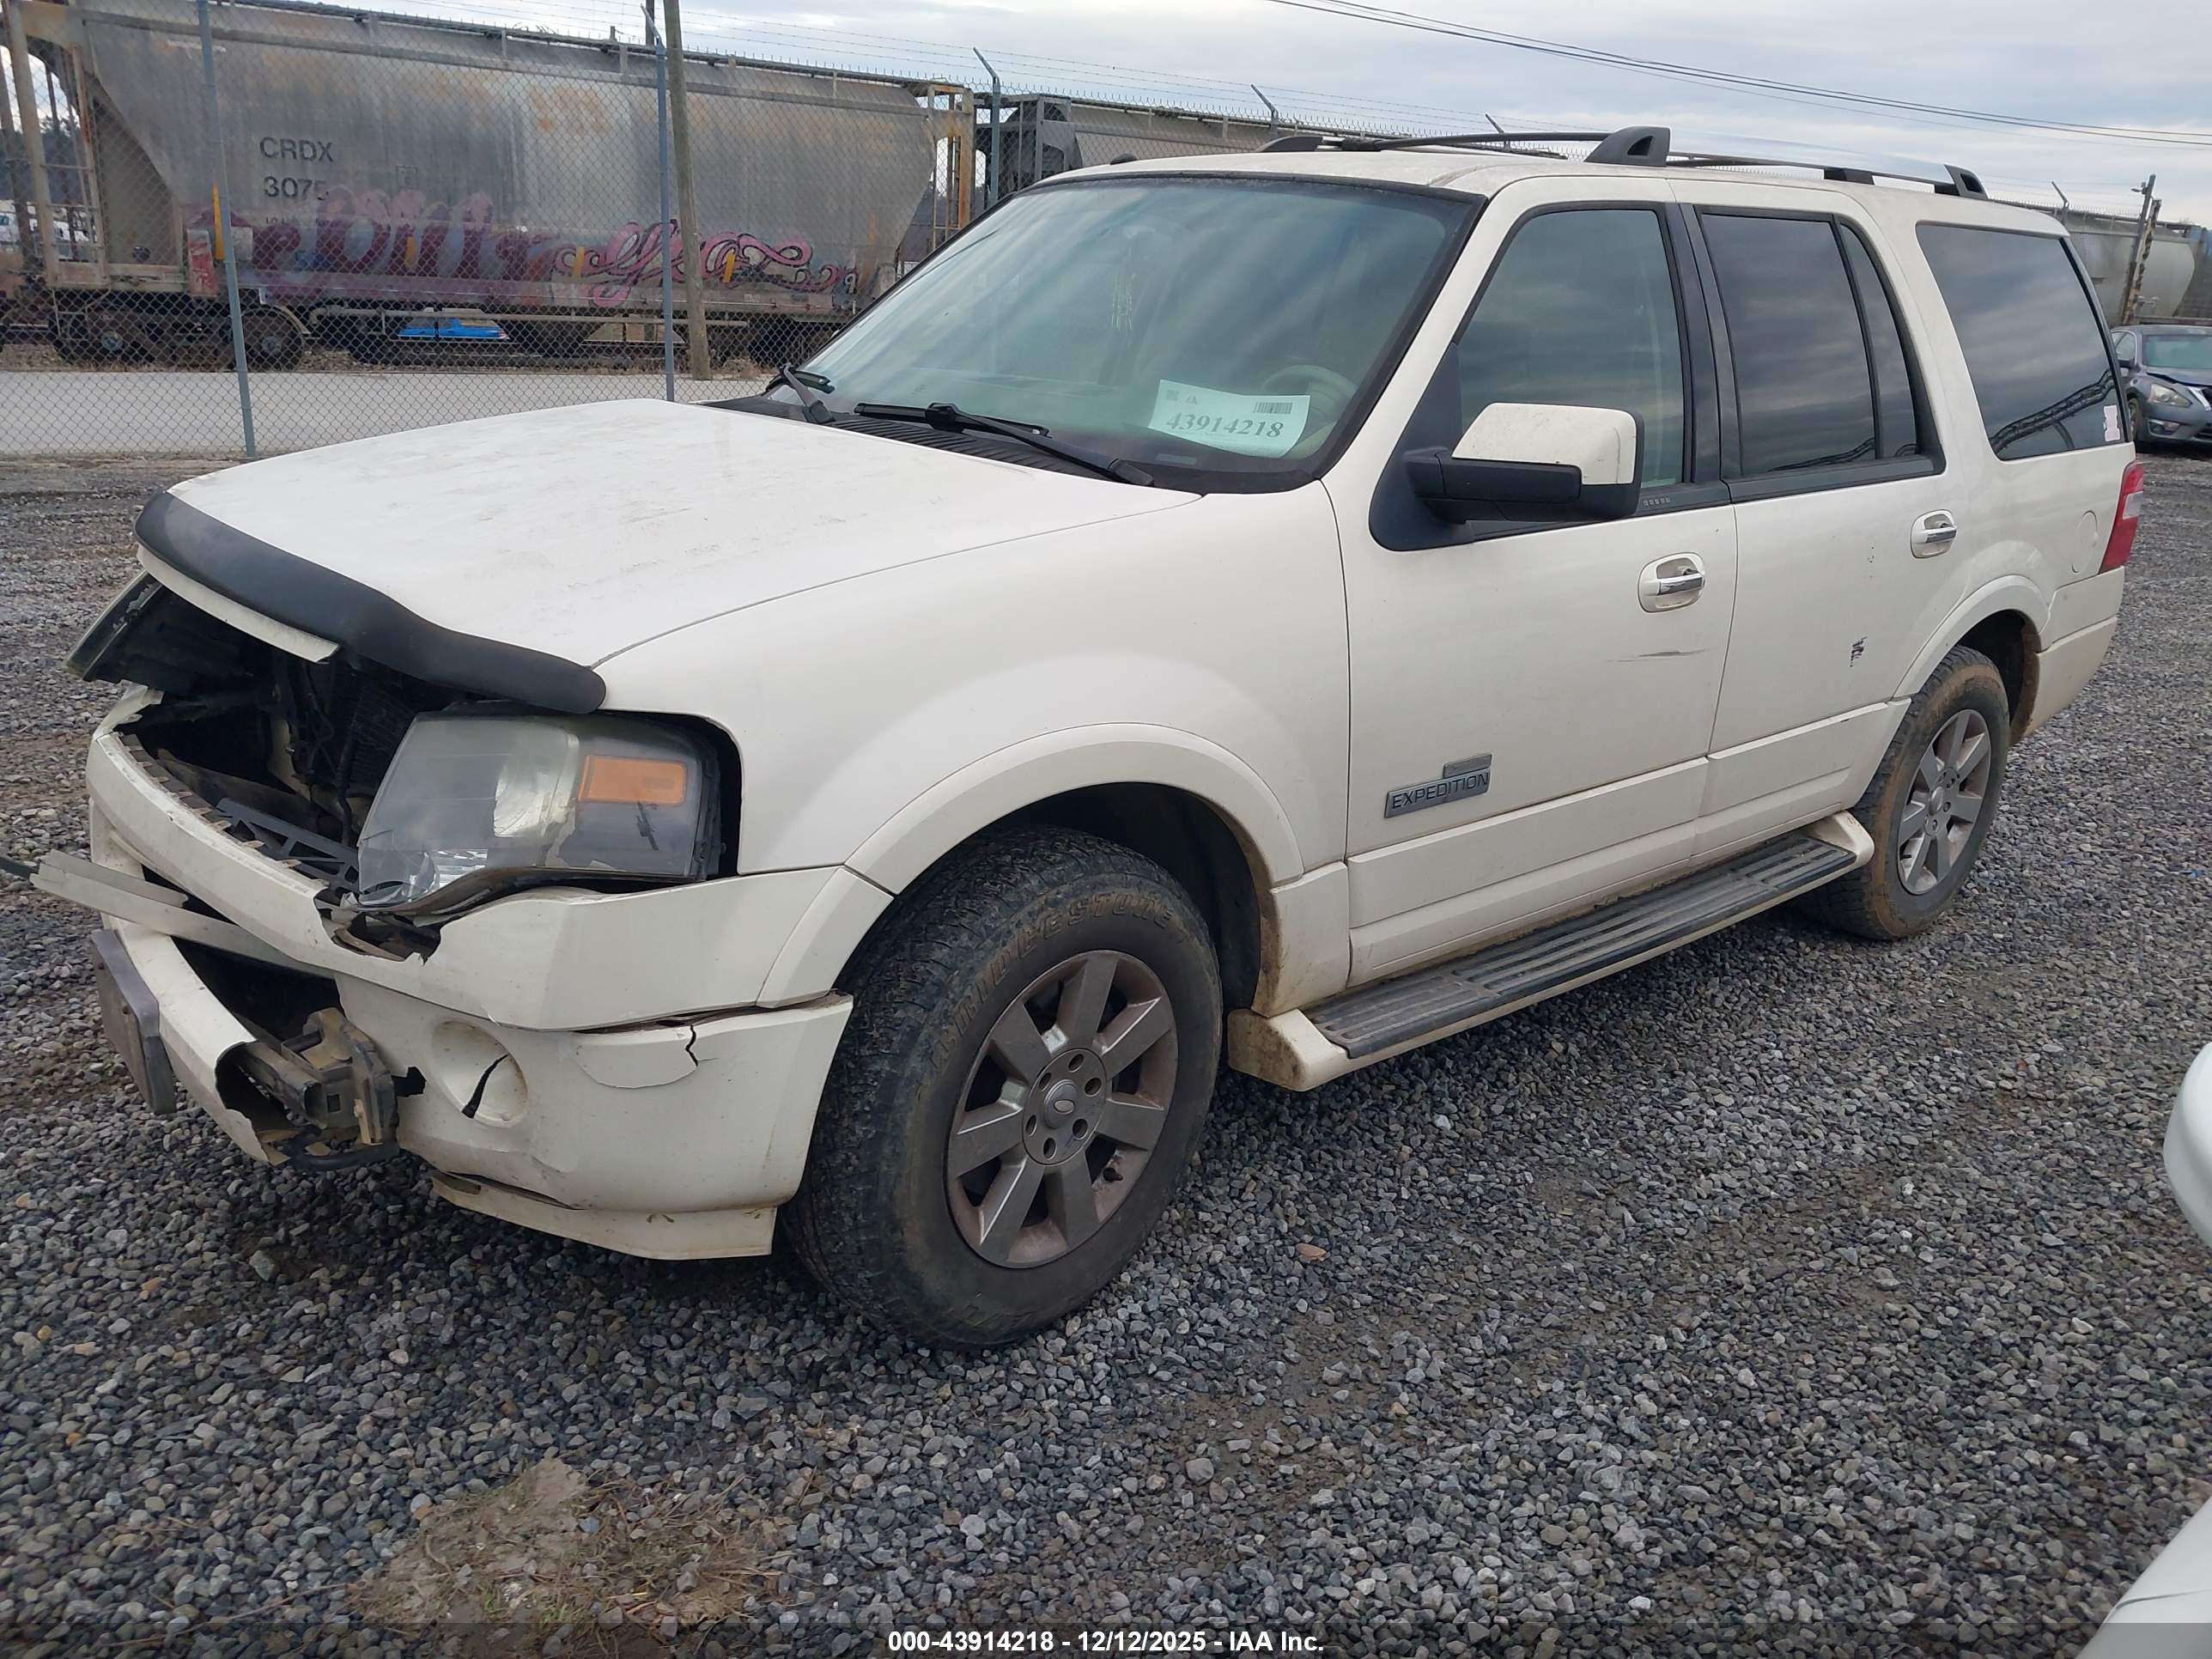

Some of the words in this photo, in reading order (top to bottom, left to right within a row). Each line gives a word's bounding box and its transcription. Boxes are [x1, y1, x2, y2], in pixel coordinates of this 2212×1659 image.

[259, 137, 334, 162] CRDX
[1167, 411, 1285, 438] 43914218
[1392, 772, 1490, 809] EXPEDITION
